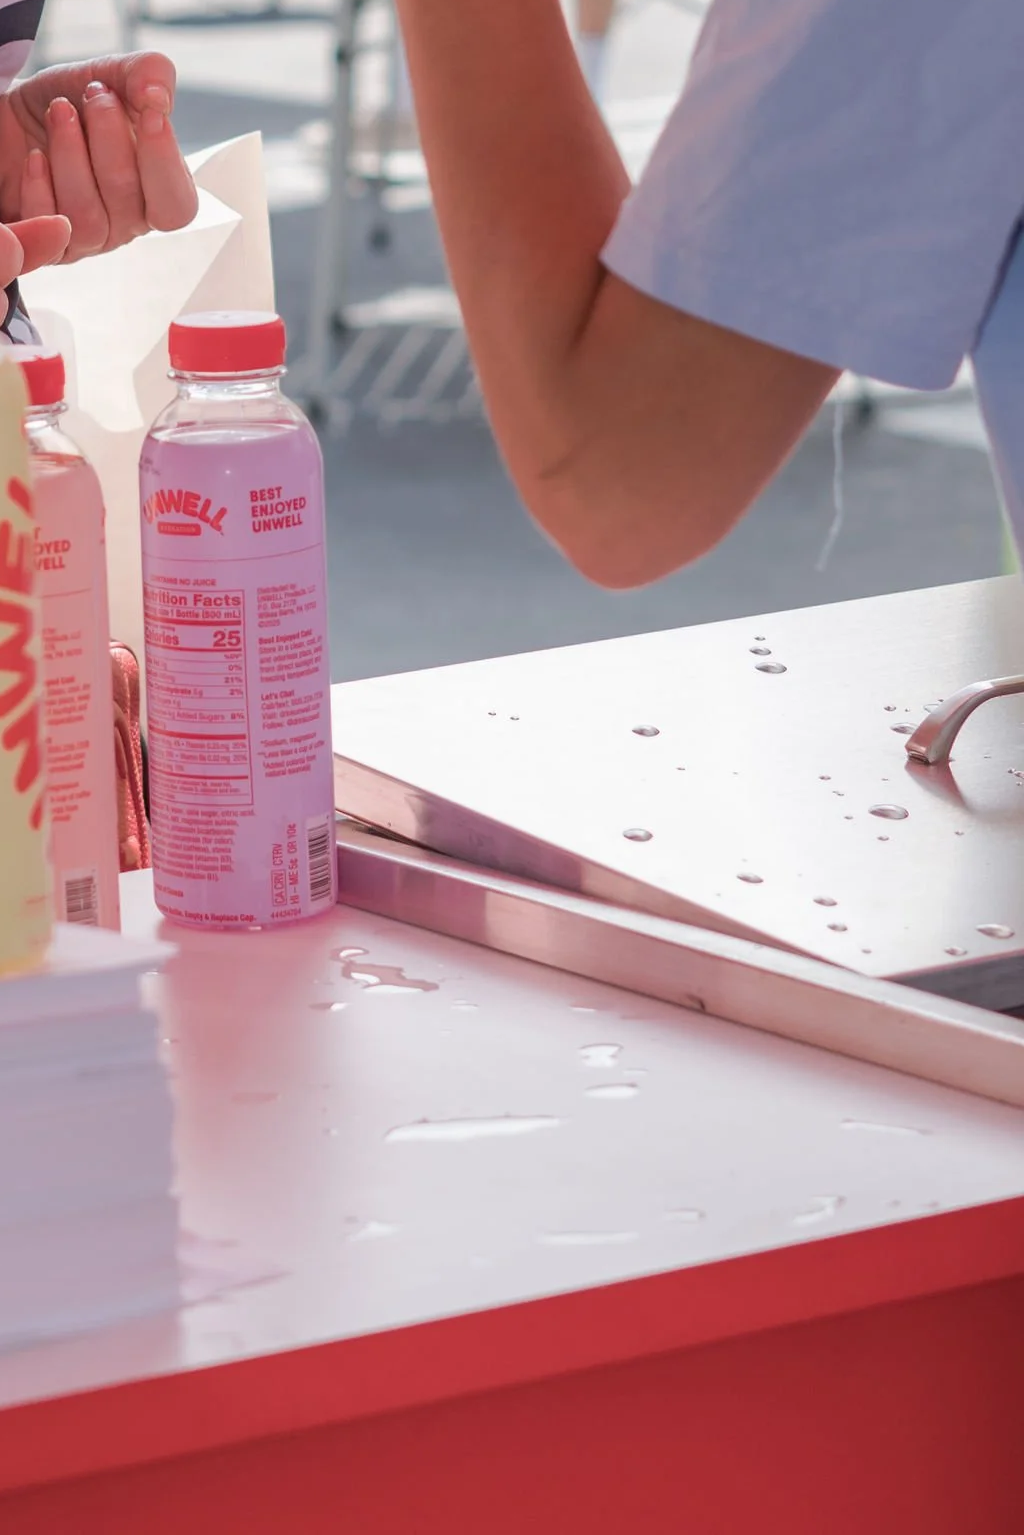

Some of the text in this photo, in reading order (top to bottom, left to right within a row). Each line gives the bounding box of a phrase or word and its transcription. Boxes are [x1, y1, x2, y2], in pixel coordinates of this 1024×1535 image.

[249, 486, 282, 502] BEST
[143, 489, 227, 536] UNWELL
[251, 497, 306, 518] ENJOYED
[252, 513, 303, 533] UNWELL
[193, 593, 241, 607] Facts
[176, 609, 199, 619] Bottle
[213, 630, 241, 647] 25
[258, 636, 274, 645] Best
[261, 692, 278, 701] Let's
